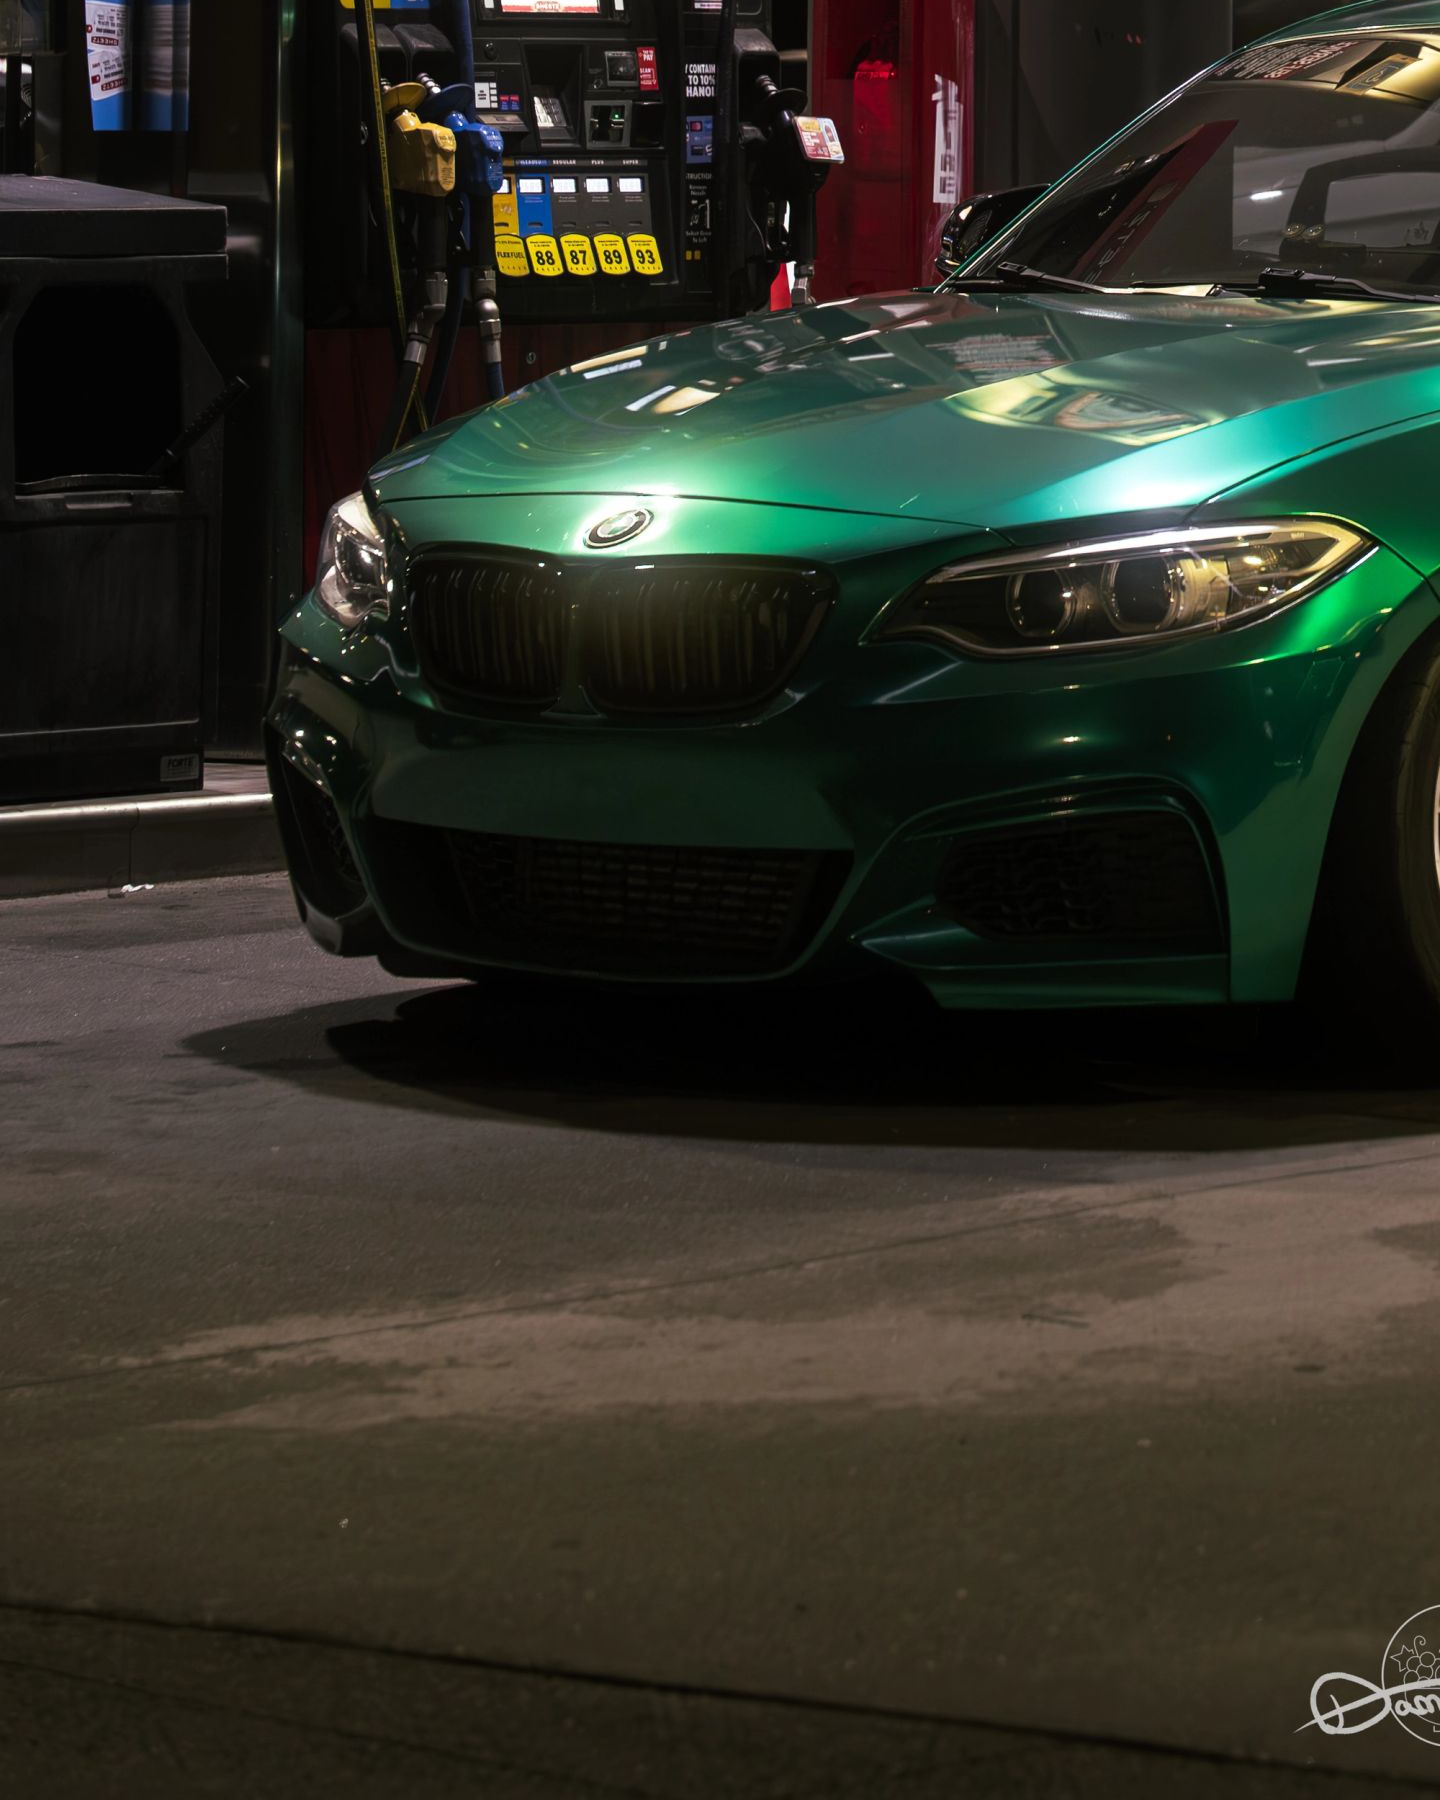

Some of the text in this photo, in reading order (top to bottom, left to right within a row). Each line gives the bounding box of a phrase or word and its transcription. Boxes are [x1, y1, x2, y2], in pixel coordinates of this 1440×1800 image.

[688, 75, 698, 85] TO
[536, 251, 555, 265] 88
[570, 250, 587, 265] 87
[603, 250, 622, 265] 89
[636, 250, 655, 264] 93
